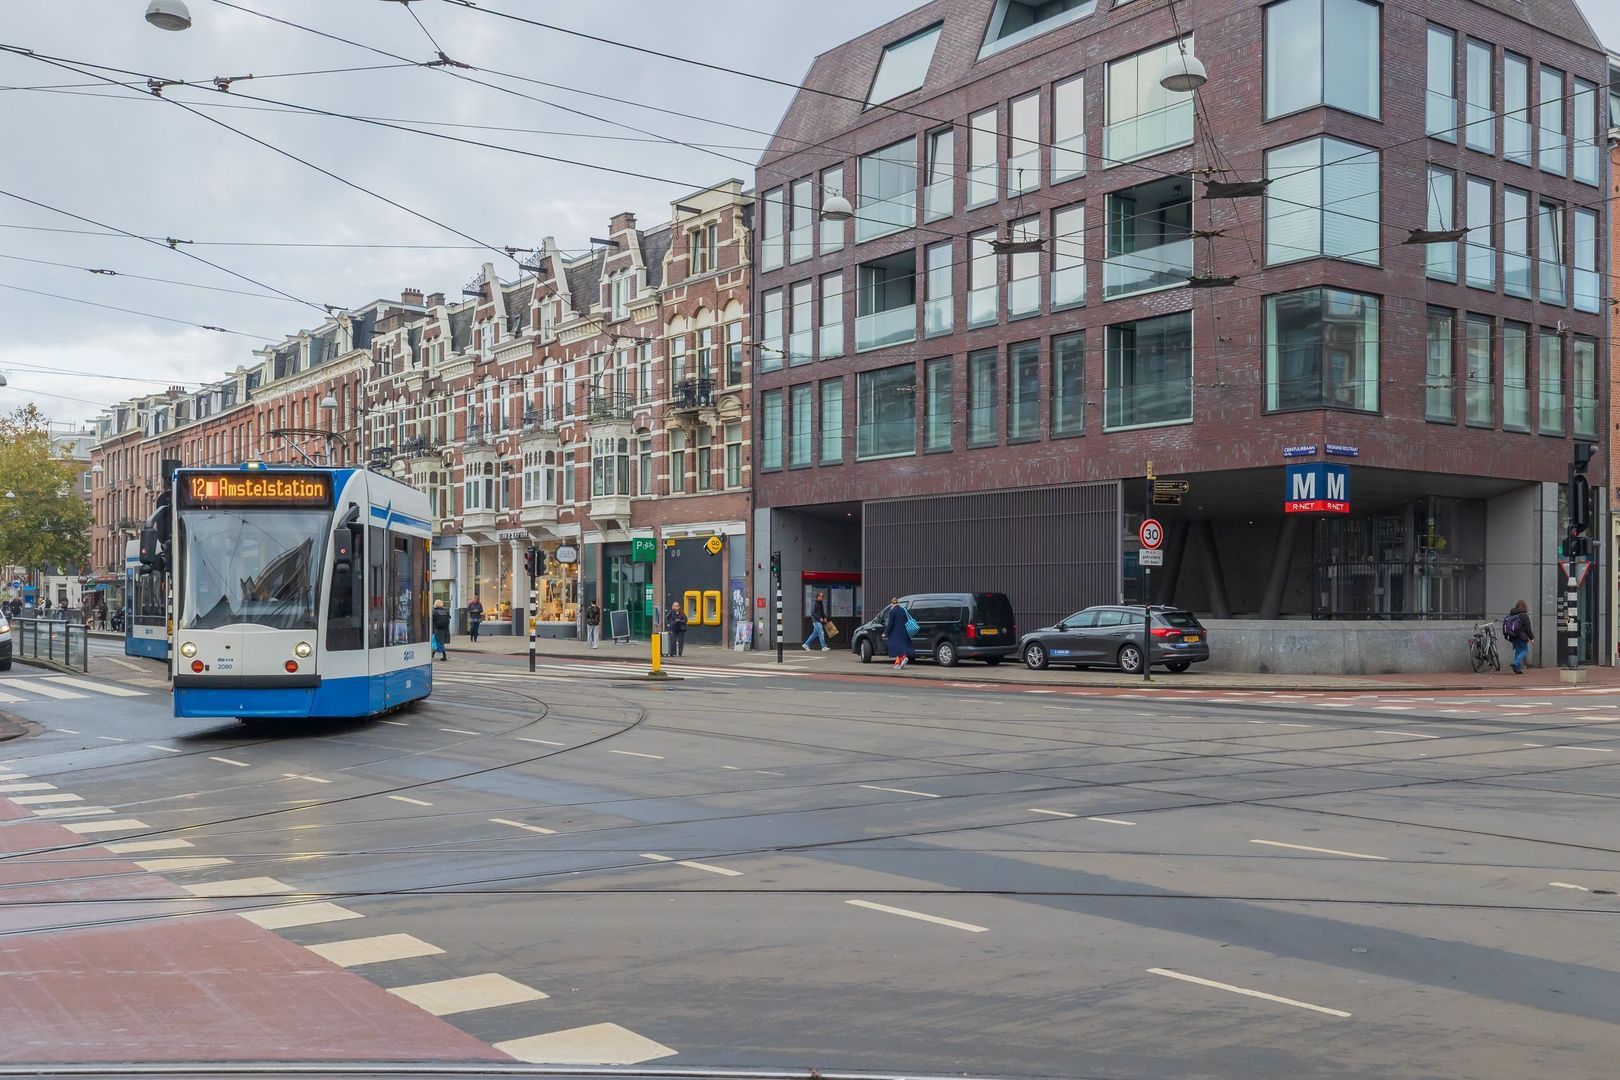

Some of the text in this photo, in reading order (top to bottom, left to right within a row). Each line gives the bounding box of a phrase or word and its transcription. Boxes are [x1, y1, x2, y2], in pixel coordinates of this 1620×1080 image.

[192, 477, 323, 497] 12 Amstelstation
[1293, 472, 1316, 499] M
[1327, 472, 1345, 500] M
[1292, 502, 1315, 510] R-NET
[1327, 502, 1344, 511] R-NET
[1145, 528, 1159, 540] 30
[636, 541, 642, 550] P
